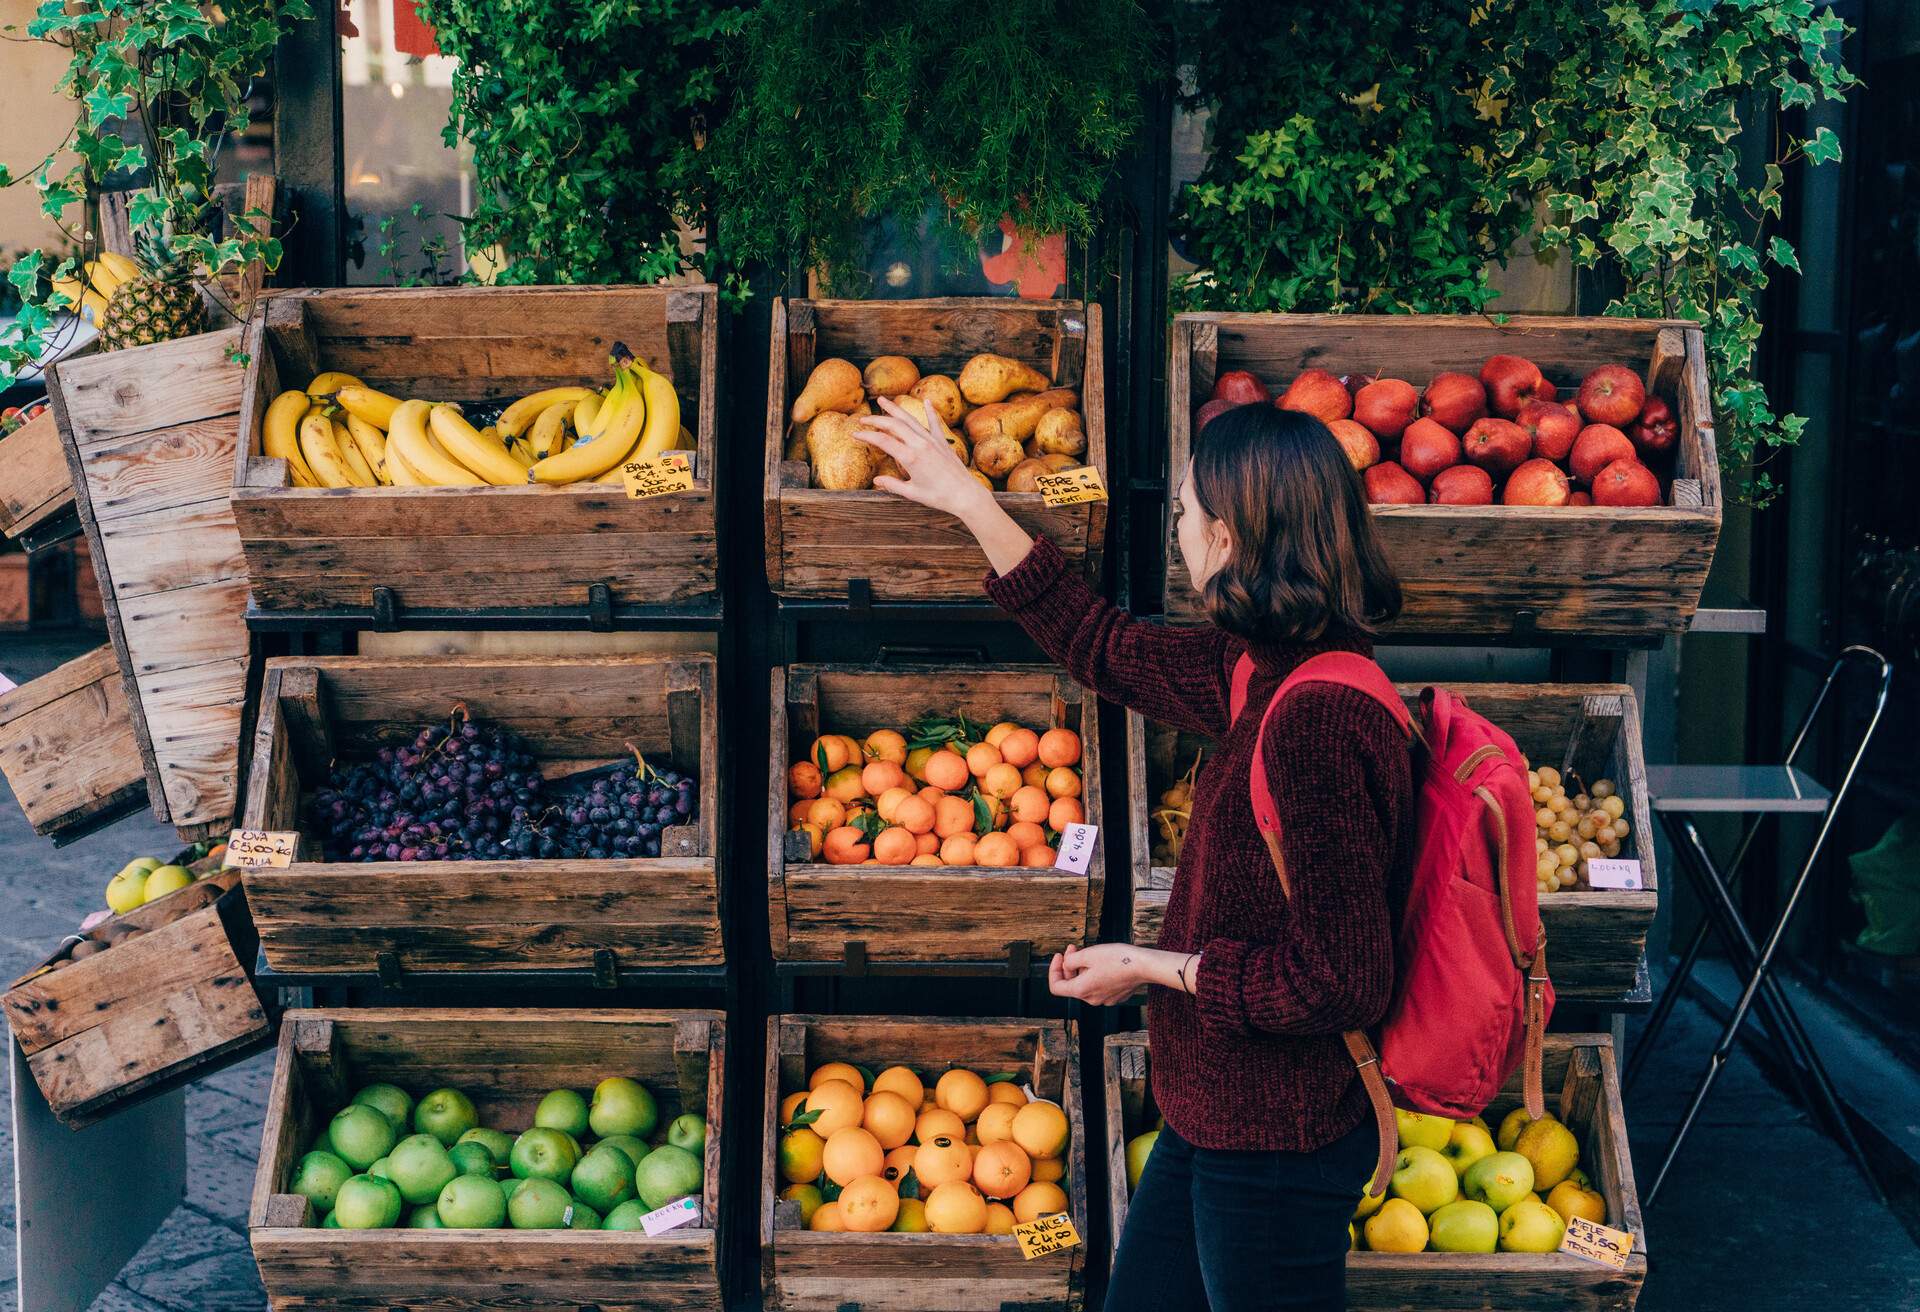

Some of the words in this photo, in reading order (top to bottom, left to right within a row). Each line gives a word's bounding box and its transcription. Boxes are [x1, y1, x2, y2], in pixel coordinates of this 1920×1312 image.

[1036, 476, 1074, 487] PERE
[241, 831, 268, 842] UVA
[1571, 1217, 1606, 1237] MELE
[1031, 1241, 1064, 1257] ITALIA
